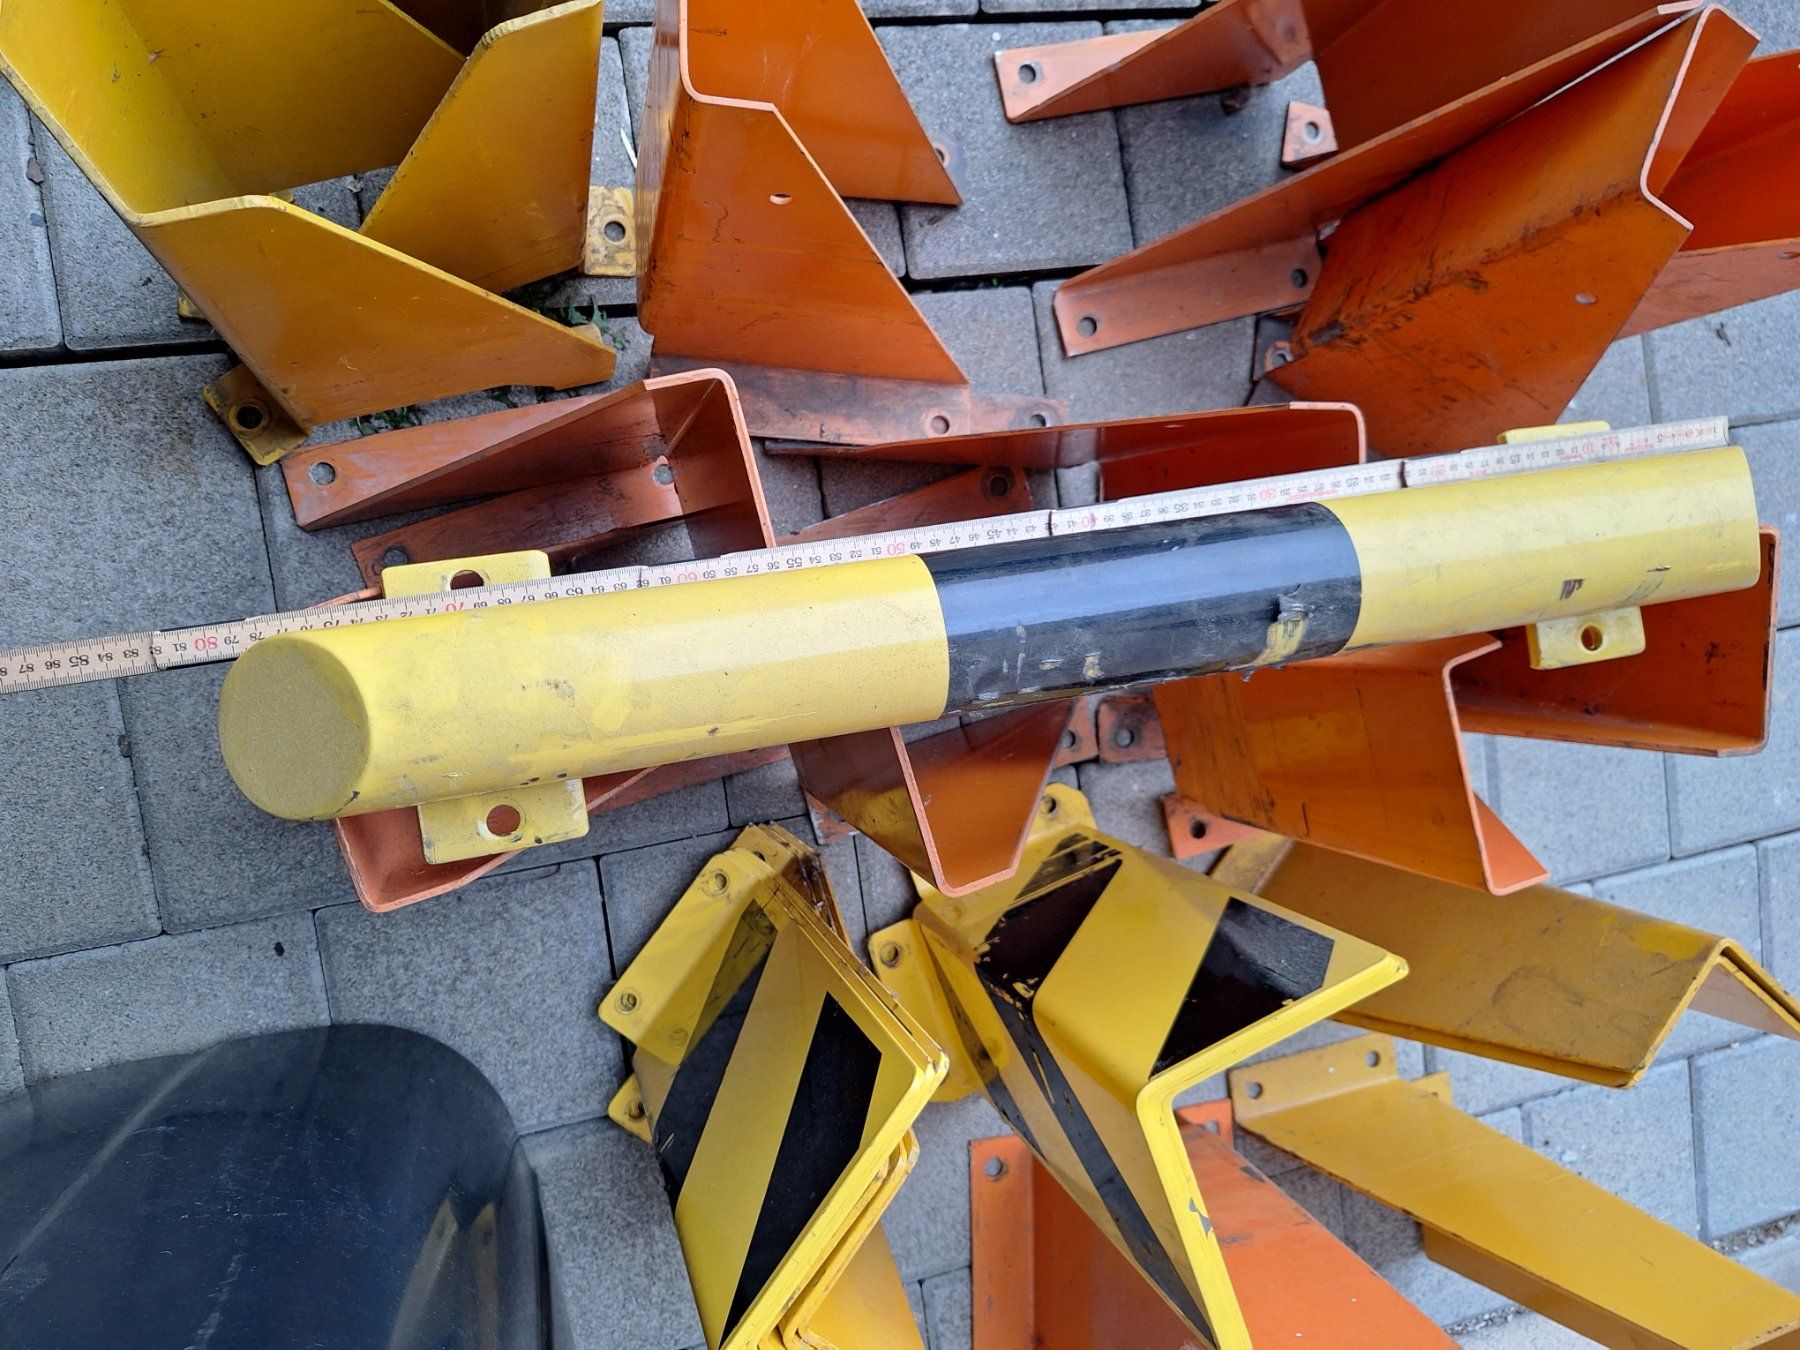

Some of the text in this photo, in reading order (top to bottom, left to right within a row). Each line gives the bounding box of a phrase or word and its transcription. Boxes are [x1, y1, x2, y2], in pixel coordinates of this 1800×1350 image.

[1582, 442, 1595, 454] 10
[1510, 454, 1520, 464] 15
[1346, 477, 1358, 488] 25
[1260, 488, 1276, 500] 30
[1157, 506, 1169, 514] 36
[1174, 502, 1188, 514] 35
[1192, 500, 1205, 510] 34
[1104, 514, 1115, 522] 39
[1121, 511, 1133, 520] 38
[1140, 508, 1151, 518] 37
[1067, 520, 1078, 528] 41
[1081, 513, 1097, 529] 40
[1006, 527, 1018, 536] 44
[1024, 524, 1037, 533] 43
[968, 533, 980, 542] 46
[986, 529, 1002, 540] 45
[910, 541, 922, 550] 49
[930, 538, 942, 548] 48
[950, 536, 961, 545] 47
[850, 550, 862, 558] 52
[870, 546, 882, 555] 51
[886, 542, 906, 556] 50
[809, 555, 822, 565] 54
[829, 552, 842, 562] 53
[767, 562, 780, 570] 56
[786, 557, 803, 569] 55
[724, 567, 738, 576] 58
[746, 564, 760, 574] 57
[677, 572, 698, 583] 60
[702, 570, 716, 579] 59
[636, 579, 650, 588] 62
[660, 576, 672, 584] 61
[591, 586, 605, 594] 64
[613, 582, 628, 590] 63
[544, 592, 559, 600] 66
[566, 587, 584, 596] 65
[522, 594, 536, 604] 67
[224, 636, 240, 645] 79
[250, 632, 265, 642] 78
[172, 642, 188, 652] 81
[194, 636, 218, 650] 80
[97, 652, 114, 662] 84
[122, 648, 140, 659] 83
[44, 660, 60, 670] 86
[70, 654, 90, 668] 85
[0, 666, 8, 677] 8
[20, 663, 35, 674] 87
